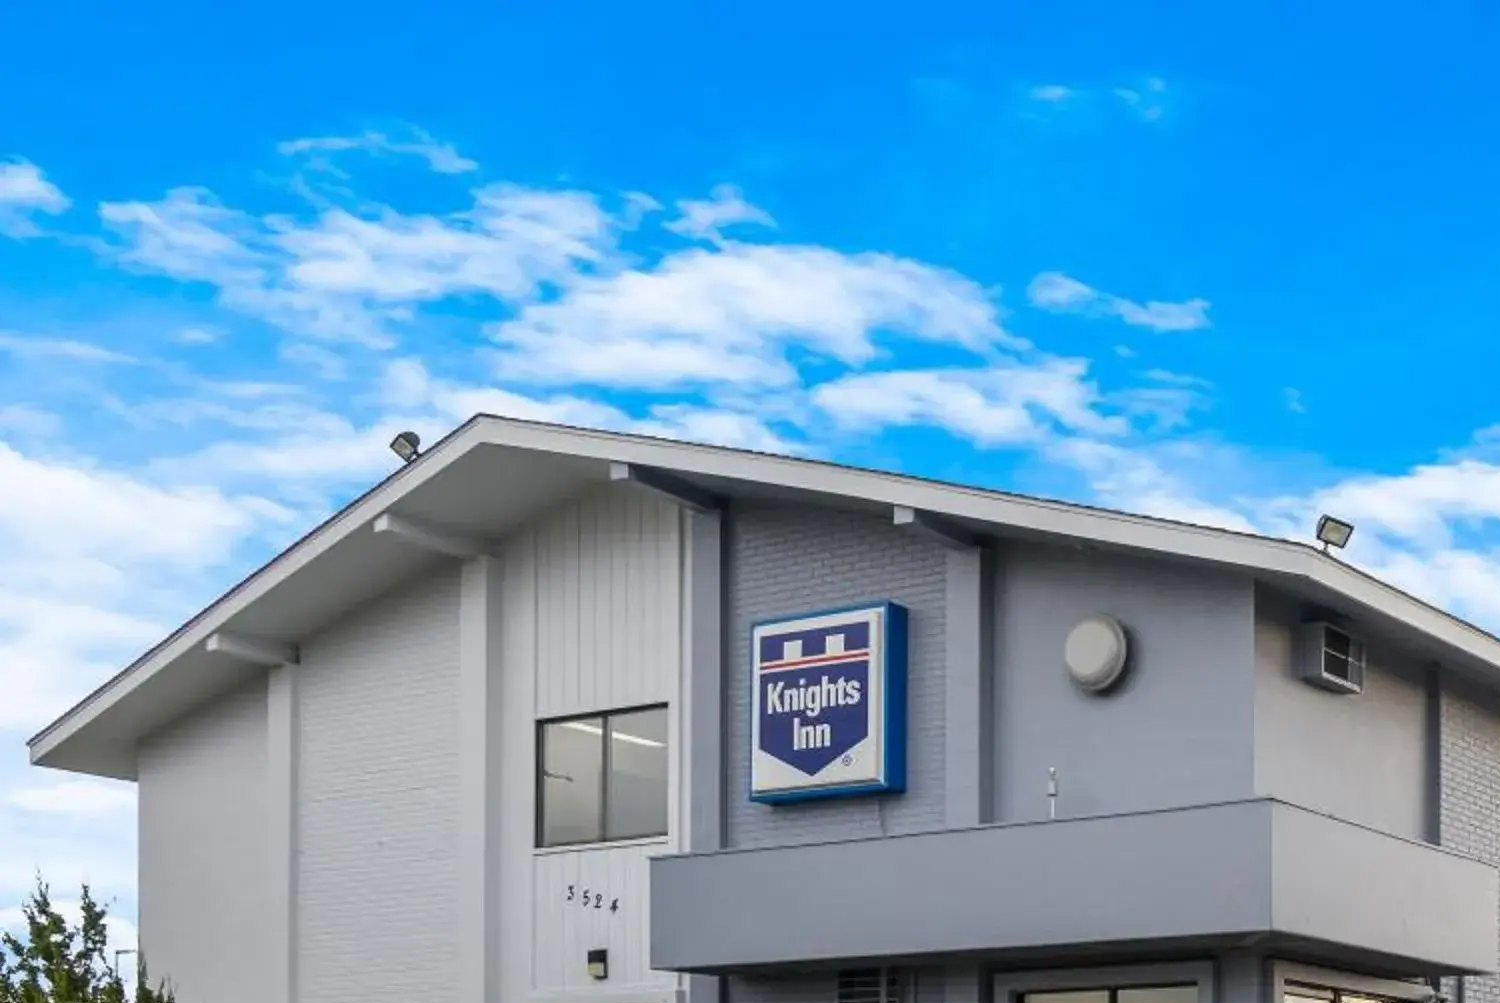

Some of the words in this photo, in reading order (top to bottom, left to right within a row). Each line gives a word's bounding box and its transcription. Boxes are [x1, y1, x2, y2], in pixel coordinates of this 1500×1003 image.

[766, 675, 861, 717] Knights
[793, 717, 831, 751] Inn
[566, 885, 619, 914] 3524
